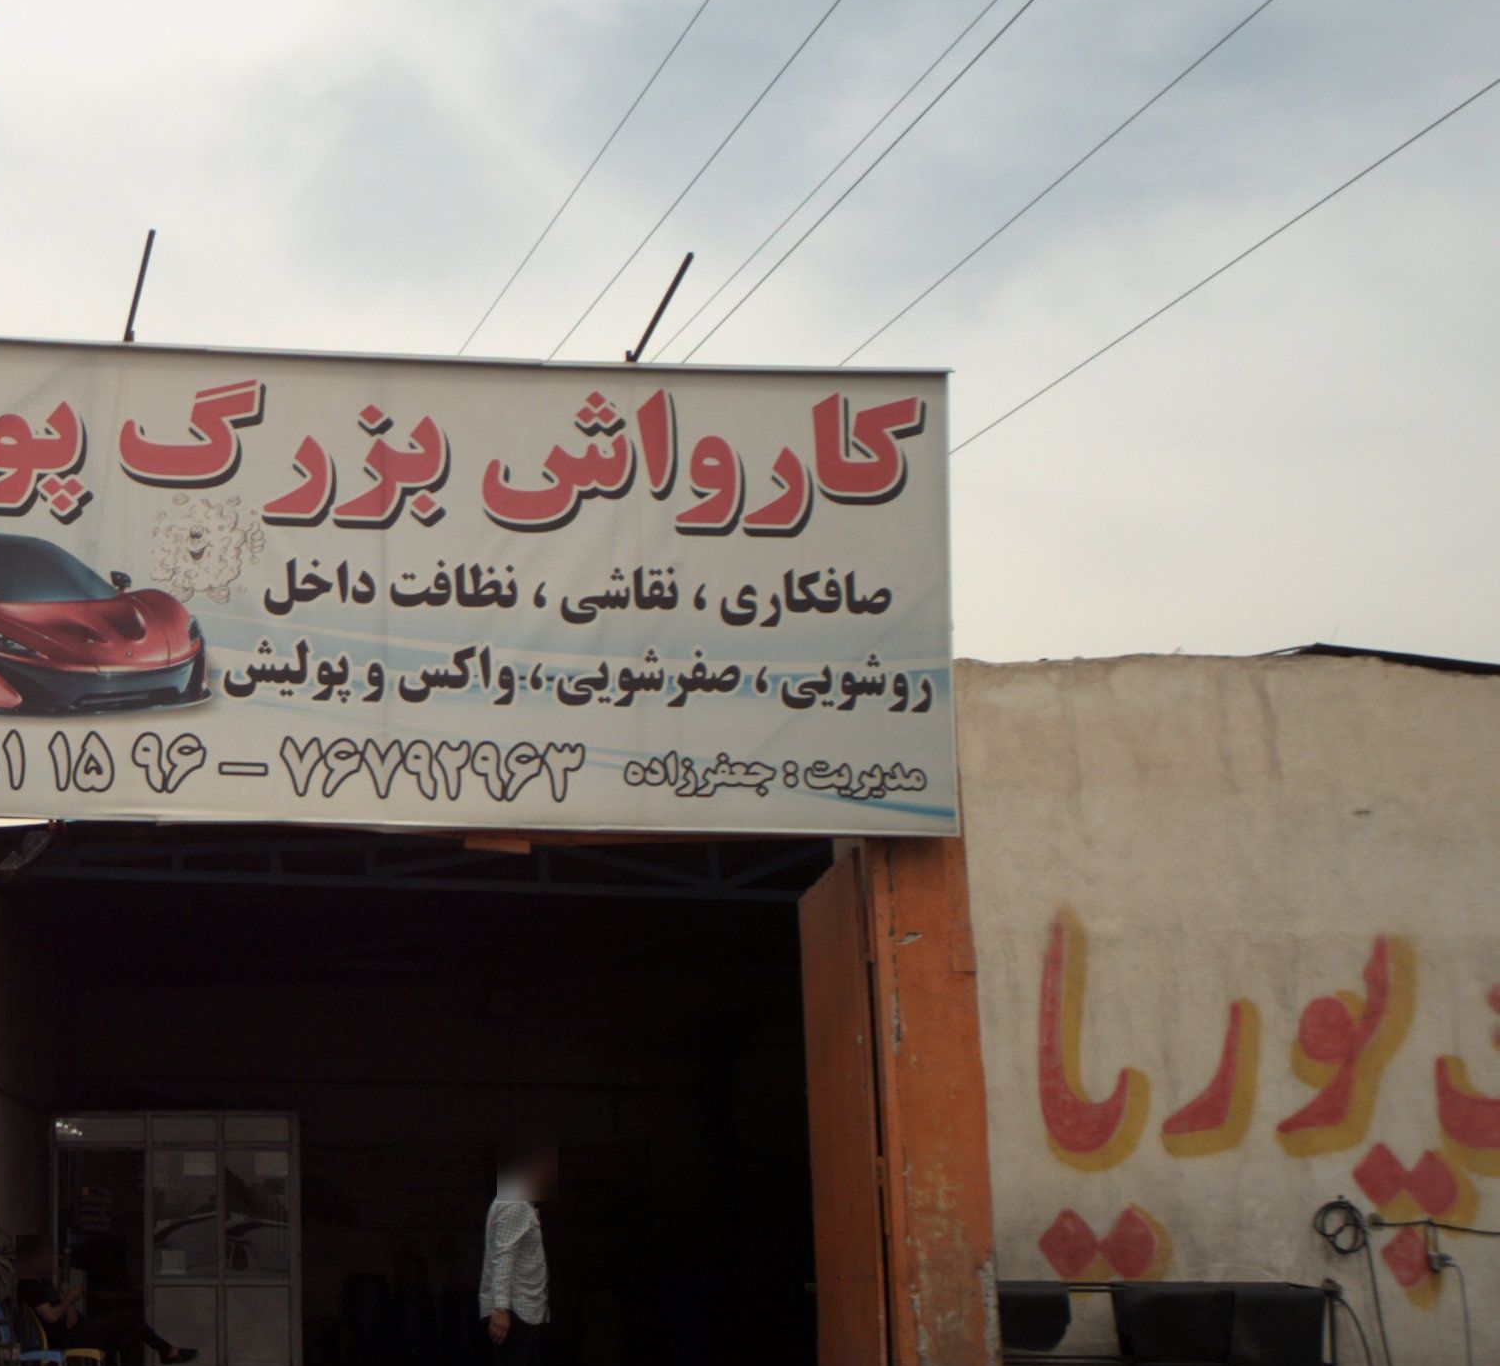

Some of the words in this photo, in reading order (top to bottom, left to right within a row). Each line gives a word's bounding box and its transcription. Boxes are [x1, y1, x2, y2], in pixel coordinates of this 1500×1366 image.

[119, 378, 451, 527] بزرگ
[480, 387, 928, 537] کارواش
[263, 556, 377, 616] داخل
[389, 558, 519, 609] نظافت
[560, 565, 680, 625] نقاشی
[719, 565, 893, 628] صافکاری
[223, 639, 352, 704] پولیش
[361, 661, 386, 703] و
[398, 644, 516, 705] واکس
[48, 731, 115, 793] ۱۵
[131, 731, 208, 794] ۹۶
[279, 735, 587, 803] ۷۶۷۹۲۹۶۳
[623, 750, 777, 797] جعفرزاده
